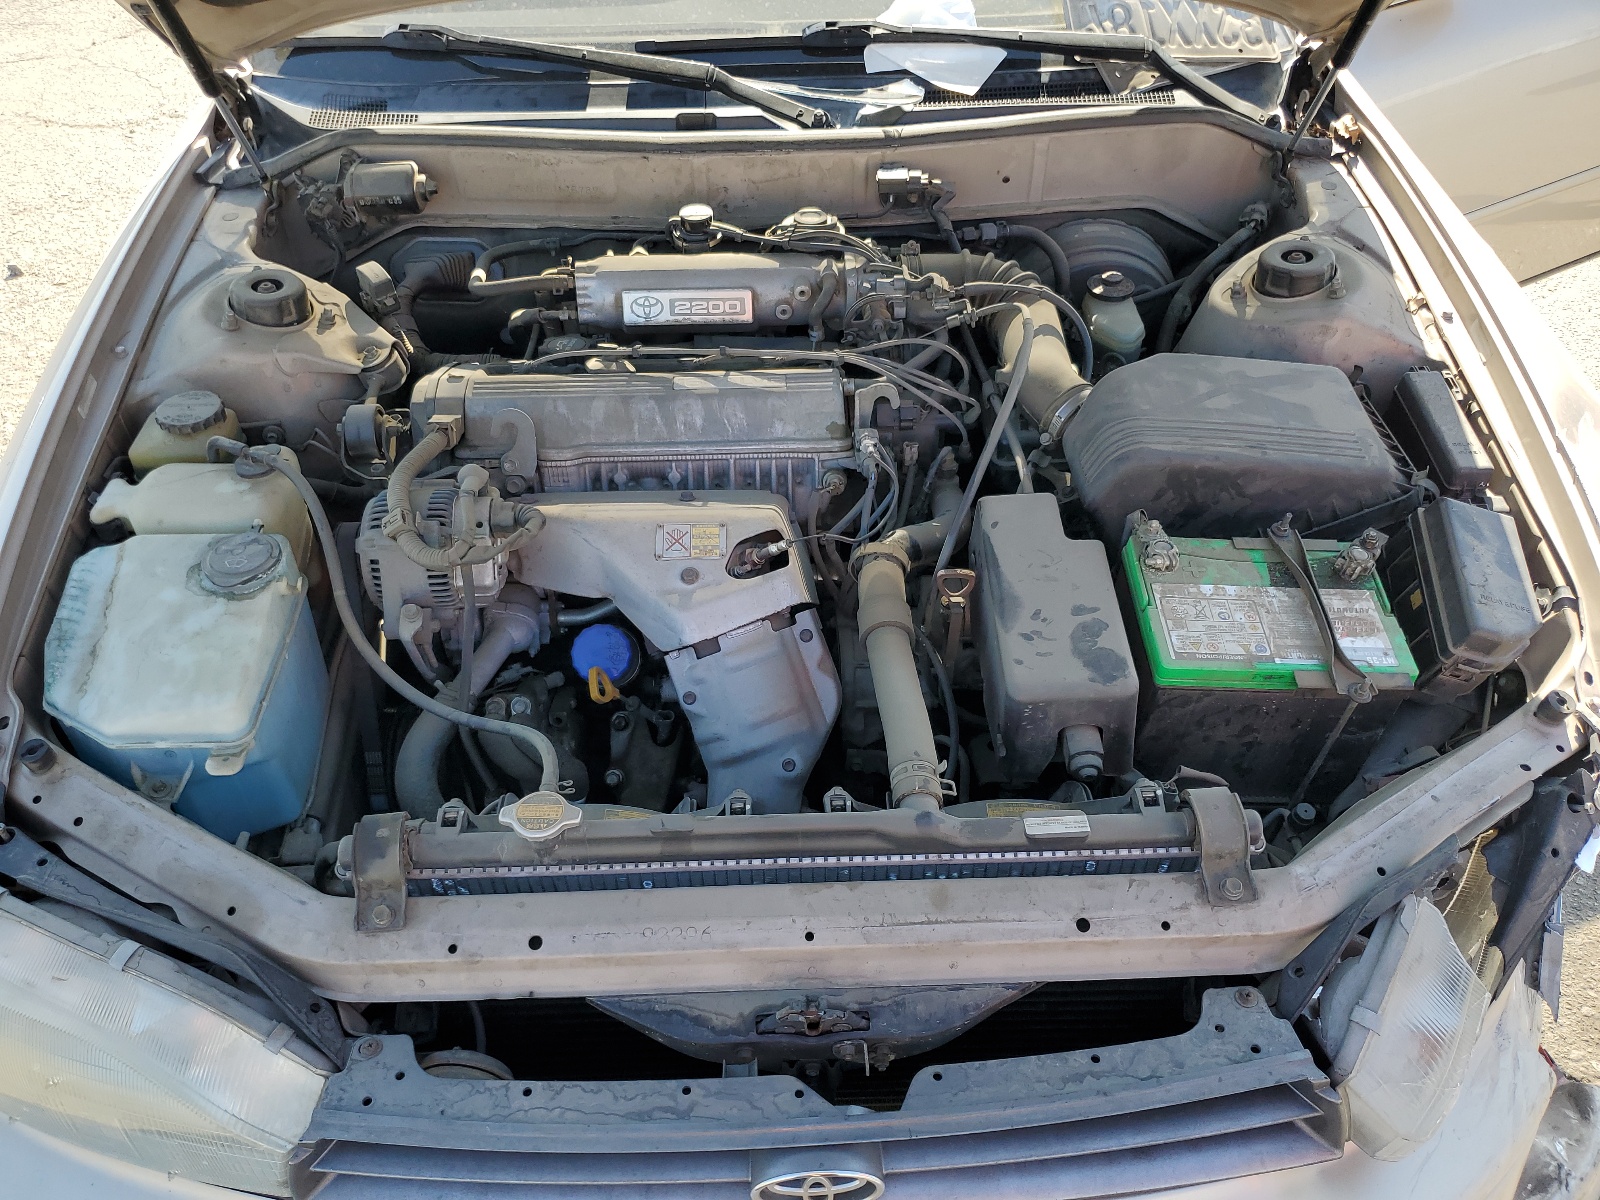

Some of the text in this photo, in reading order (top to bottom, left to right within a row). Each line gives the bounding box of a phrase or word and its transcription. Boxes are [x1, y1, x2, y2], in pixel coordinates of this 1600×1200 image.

[674, 300, 741, 314] 2200
[1328, 606, 1370, 614] AUTOMOTI
[1366, 656, 1396, 664] MT-35
